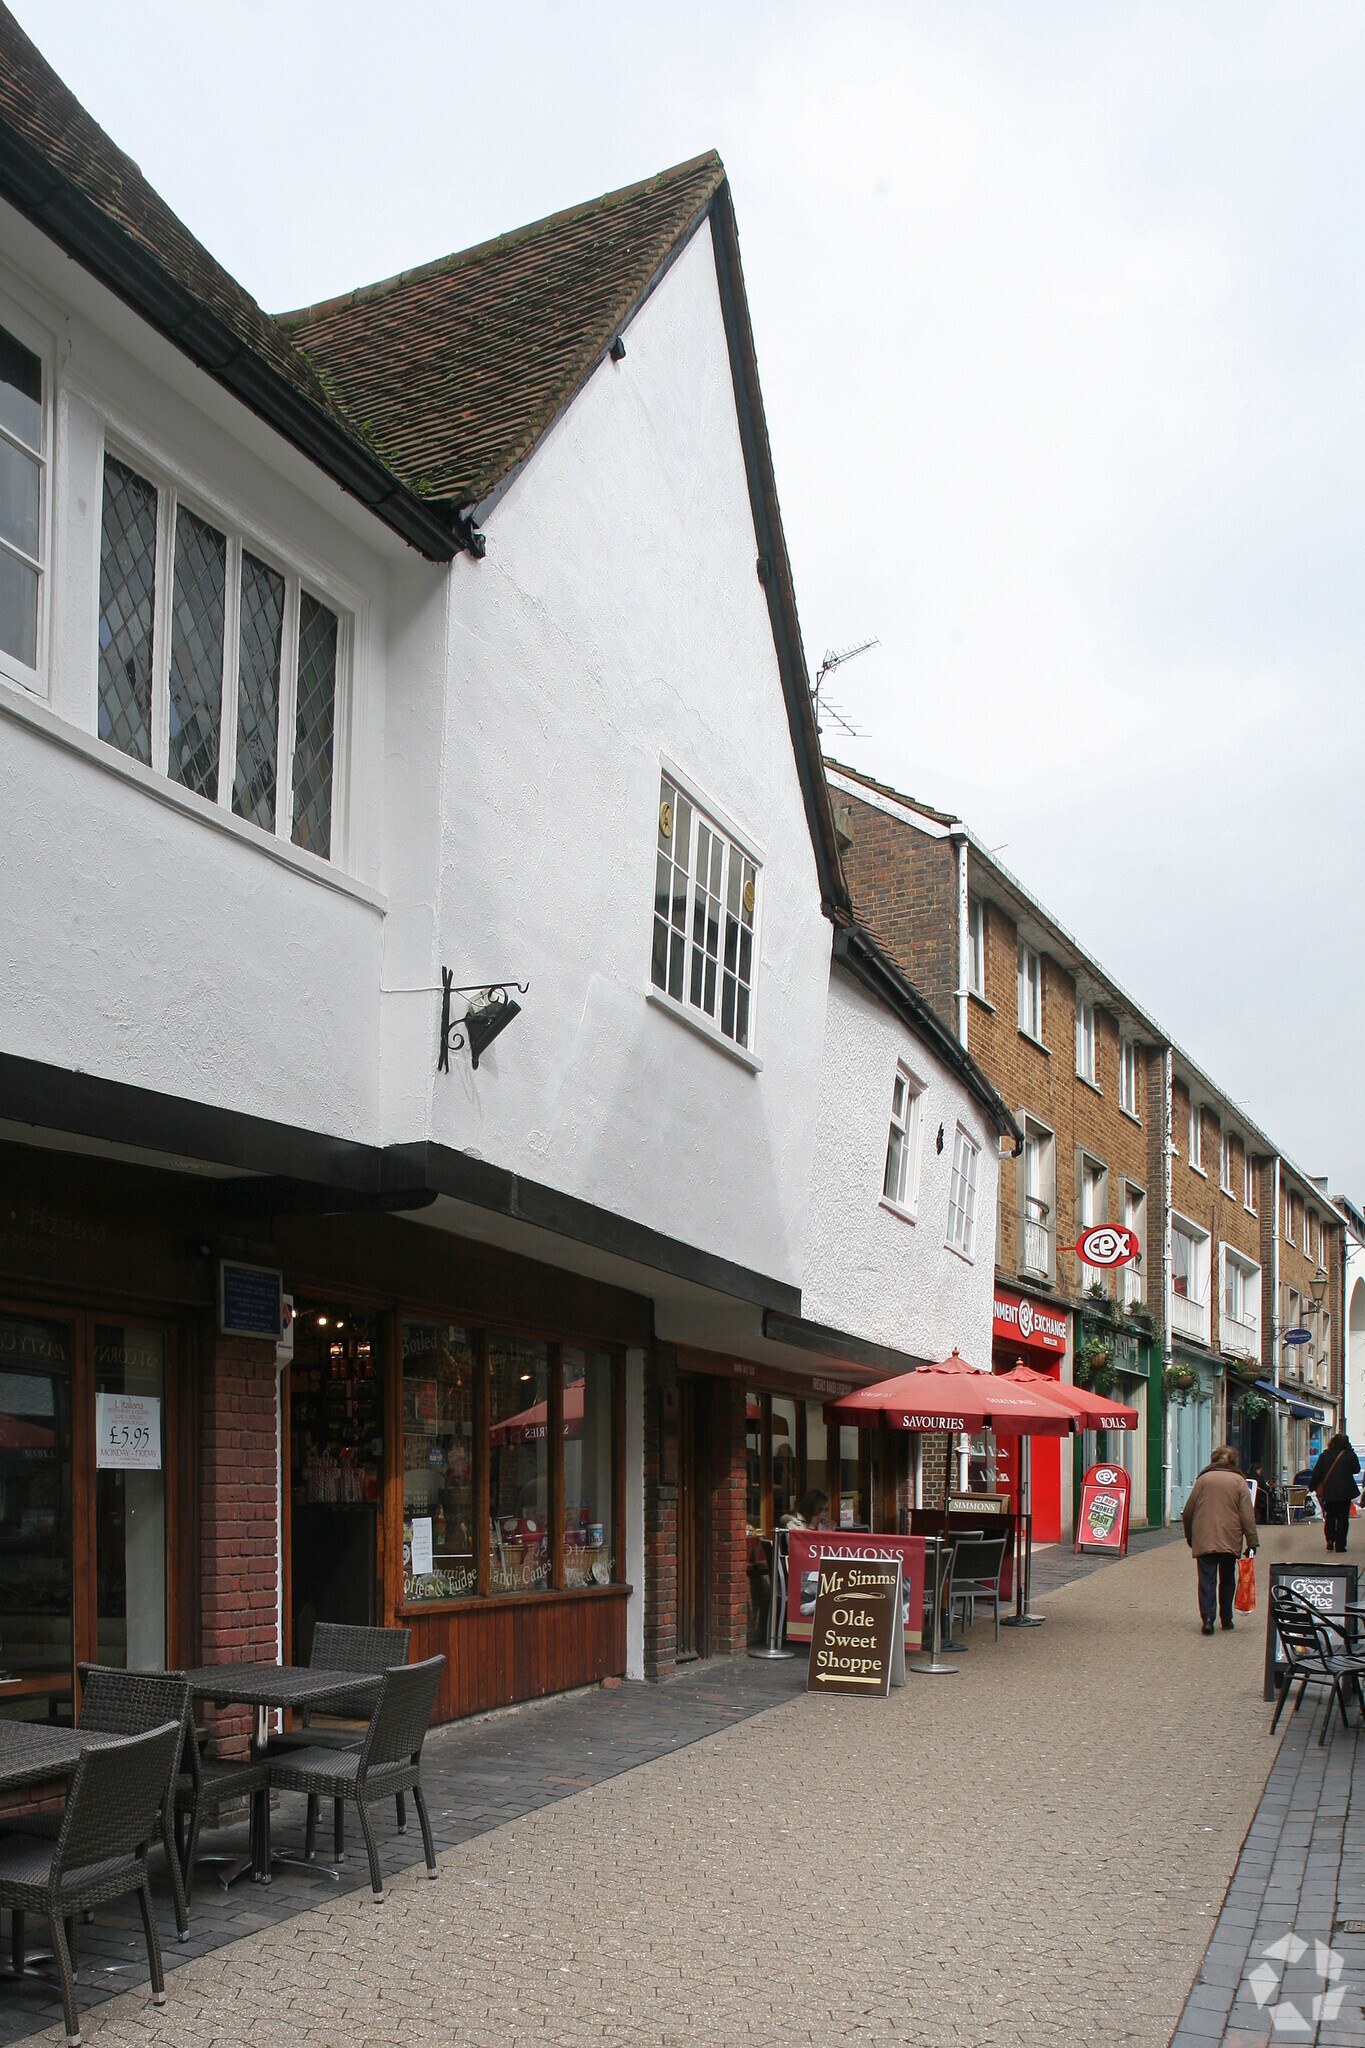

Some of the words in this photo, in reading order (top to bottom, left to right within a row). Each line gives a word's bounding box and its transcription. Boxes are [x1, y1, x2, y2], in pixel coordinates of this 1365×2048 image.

[1034, 1313, 1066, 1339] EXCHANGE
[903, 1415, 964, 1429] SAVOURIES
[1100, 1416, 1126, 1429] ROLLS
[110, 1426, 149, 1449] £5.95
[100, 1448, 129, 1456] MONDAY
[135, 1449, 157, 1457] FRIDAY
[953, 1501, 996, 1511] SIMMONS
[1091, 1503, 1114, 1514] PHONES
[1090, 1512, 1109, 1525] CASH
[808, 1545, 904, 1562] SIMMONS
[522, 1559, 552, 1585] Canes
[449, 1568, 478, 1596] Fudge
[819, 1571, 844, 1597] Mr
[848, 1569, 896, 1588] Simms
[1291, 1578, 1334, 1595] Good
[832, 1609, 874, 1627] Olde
[825, 1630, 877, 1649] Sweet
[817, 1653, 882, 1673] Shoppe
